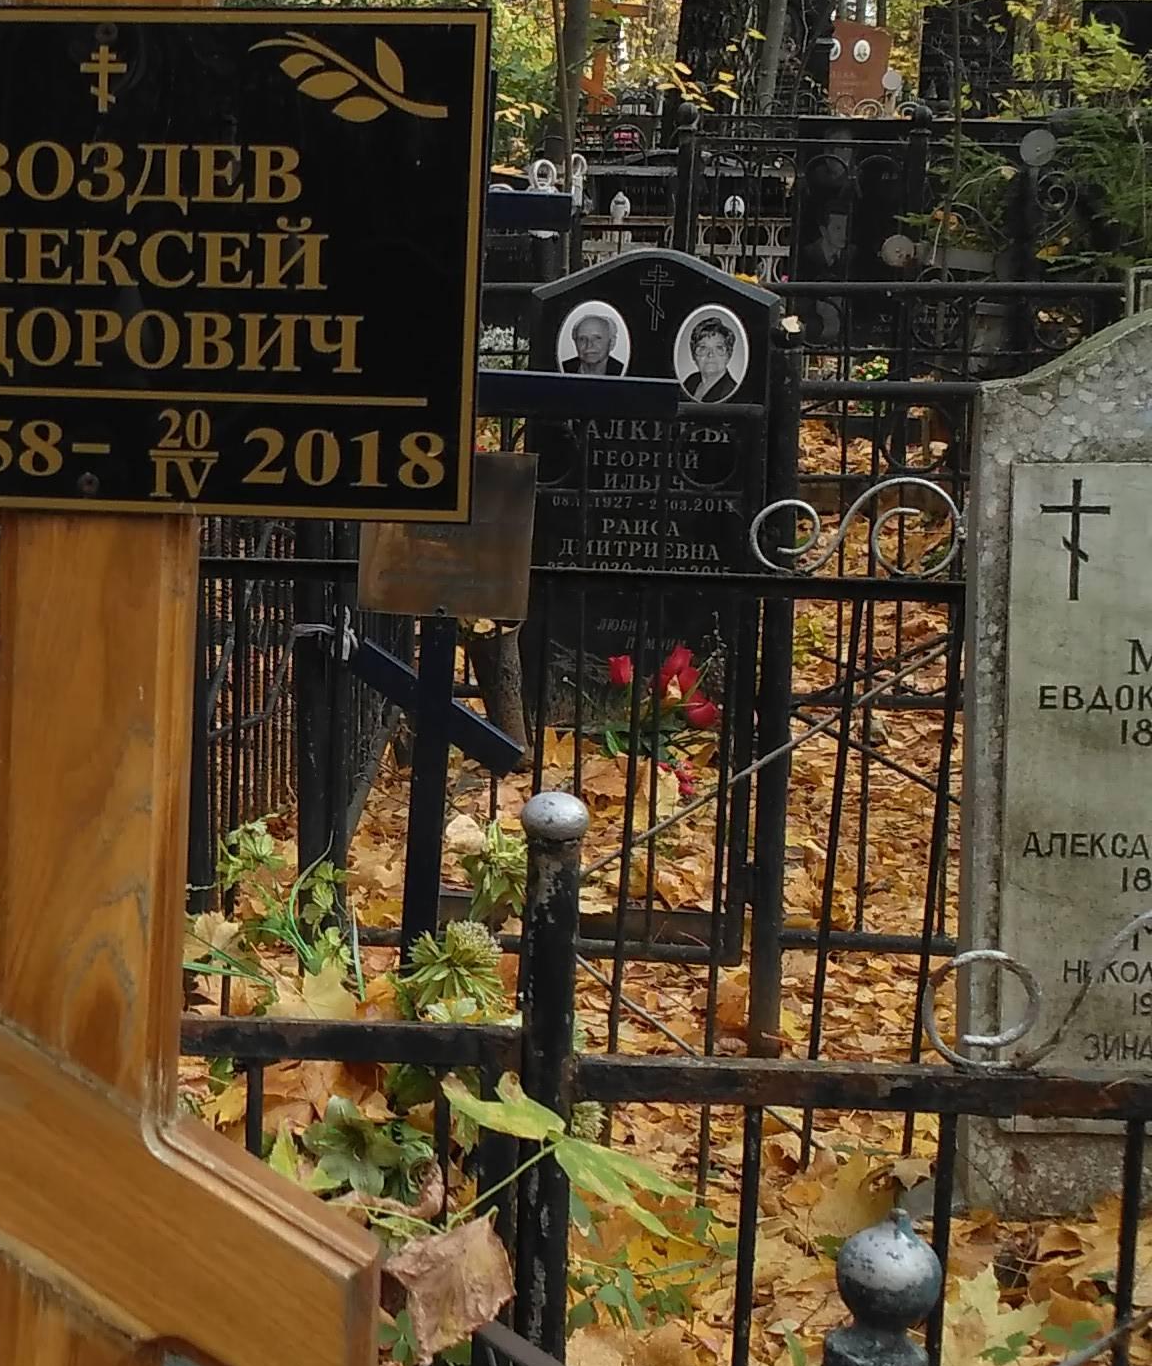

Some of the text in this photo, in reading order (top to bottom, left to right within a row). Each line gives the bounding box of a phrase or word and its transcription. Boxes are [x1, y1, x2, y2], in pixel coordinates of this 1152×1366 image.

[157, 408, 212, 450] 20
[150, 457, 219, 499] IV
[242, 427, 446, 490] 2018
[552, 495, 633, 510] 08.1.1927
